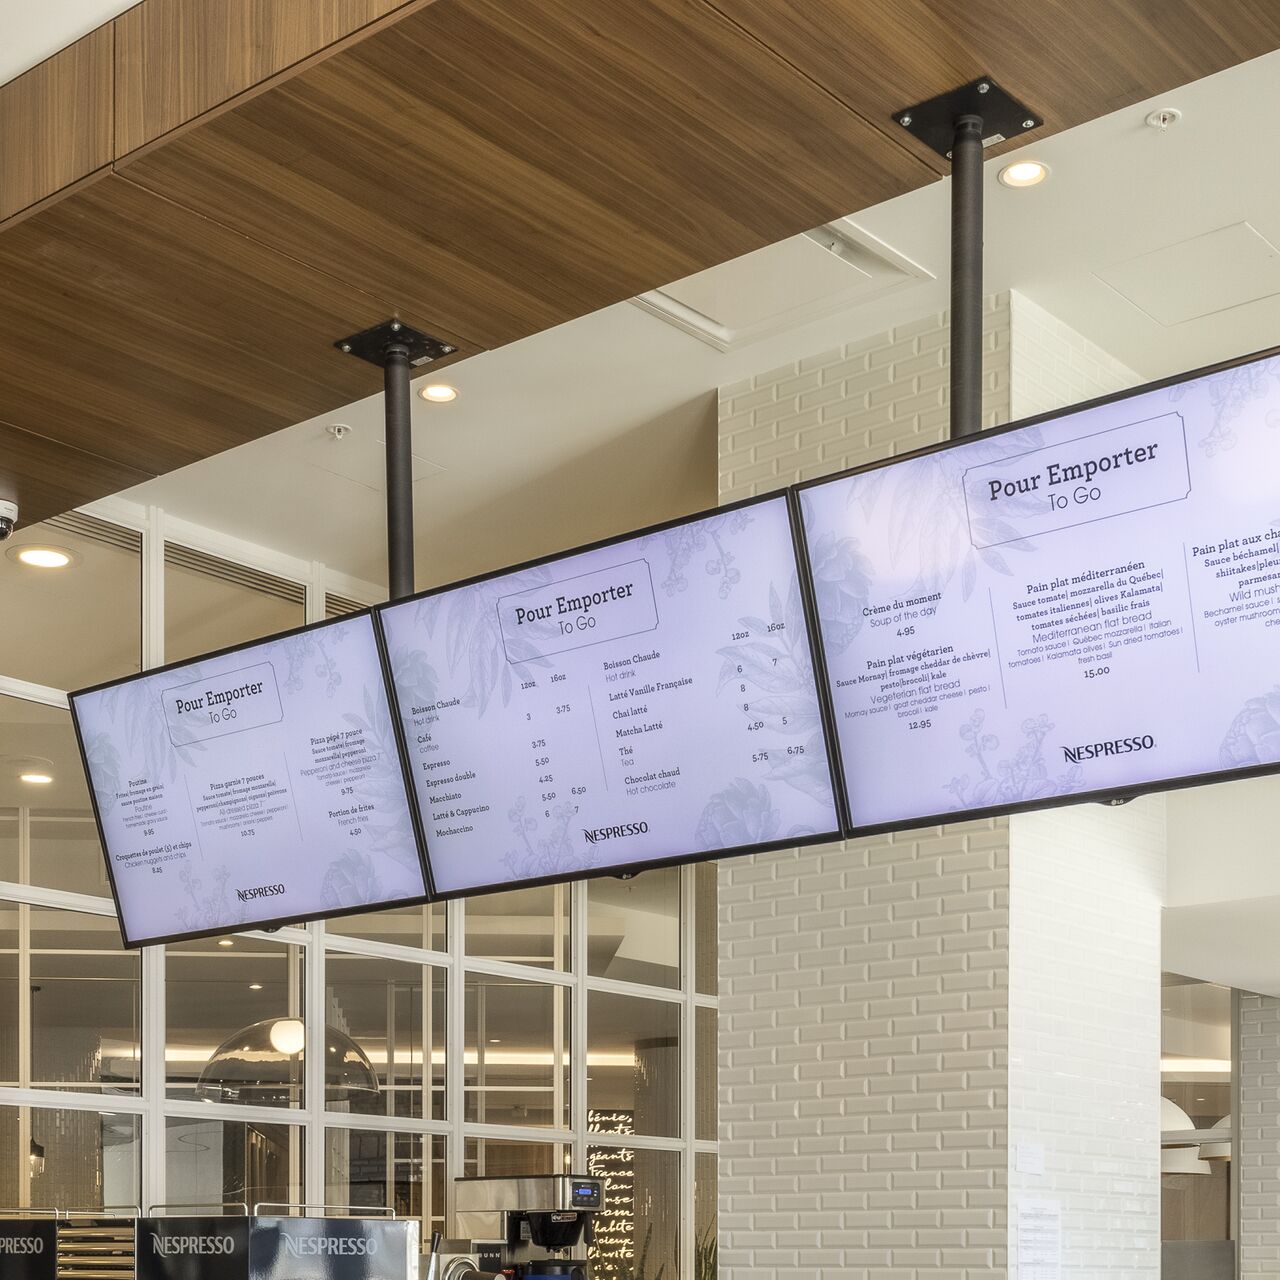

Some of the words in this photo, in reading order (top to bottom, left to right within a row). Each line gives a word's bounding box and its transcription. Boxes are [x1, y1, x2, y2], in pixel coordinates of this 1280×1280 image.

[988, 474, 1041, 502] Pour
[1046, 443, 1158, 486] Emporter
[1047, 493, 1069, 512] To
[1073, 486, 1102, 505] Go
[1192, 544, 1216, 557] Pain
[1218, 539, 1240, 554] plat
[1241, 534, 1262, 546] aux
[1026, 582, 1049, 595] Pain
[1050, 577, 1070, 592] plat
[1071, 561, 1145, 585] méditerranéen
[1228, 588, 1252, 603] Wild
[514, 604, 553, 626] Pour
[555, 583, 634, 615] Emporter
[862, 604, 892, 617] Crème
[892, 599, 904, 610] du
[905, 592, 942, 607] moment
[869, 616, 893, 628] Soup
[893, 612, 902, 623] of
[903, 610, 919, 621] the
[919, 606, 937, 617] day
[557, 620, 574, 636] To
[575, 615, 597, 631] Go
[767, 622, 786, 633] 16oz
[896, 625, 916, 638] 4.95
[1032, 622, 1103, 644] Mediterranean
[1104, 616, 1120, 629] flat
[1121, 609, 1153, 625] bread
[731, 631, 750, 641] 12oz
[602, 658, 632, 671] Boisson
[632, 650, 661, 664] Chaude
[866, 658, 887, 670] Pain
[887, 654, 905, 668] plat
[905, 645, 954, 662] végétarien
[550, 673, 567, 683] 16oz
[1083, 666, 1110, 679] 15.00
[520, 681, 537, 690] 12oz
[608, 689, 629, 702] Latté
[628, 683, 656, 697] Vanille
[655, 677, 693, 692] Française
[917, 684, 932, 695] flat
[933, 679, 961, 692] bread
[175, 697, 204, 715] Pour
[205, 681, 263, 707] Emporter
[411, 704, 437, 716] Boisson
[436, 697, 461, 710] Chaude
[555, 703, 571, 715] 3.75
[612, 708, 631, 720] Chai
[629, 704, 648, 716] latté
[208, 711, 221, 724] To
[221, 707, 237, 721] Go
[615, 725, 643, 738] Matcha
[643, 720, 663, 733] Latté
[908, 719, 932, 730] 12.95
[416, 732, 432, 744] Café
[531, 738, 547, 749] 3.75
[618, 745, 634, 756] Thé
[752, 751, 769, 763] 5.75
[786, 745, 805, 755] 6.75
[1061, 734, 1154, 764] NESPRESSO
[422, 759, 451, 771] Espresso
[535, 756, 550, 767] 5.50
[425, 777, 455, 789] Espresso
[454, 770, 476, 782] double
[538, 774, 554, 784] 4.25
[624, 772, 657, 785] Chocolat
[657, 766, 681, 779] chaud
[571, 786, 587, 795] 6.50
[639, 780, 677, 794] chocolate
[428, 792, 462, 805] Macchiato
[541, 791, 557, 802] 5.50
[432, 810, 450, 821] Latté
[435, 825, 474, 838] Mochaccino
[582, 821, 649, 845] NESPRESSO
[236, 883, 286, 903] NESPRESSO
[149, 1232, 235, 1259] NESPRESSO
[280, 1232, 379, 1259] NESPRESSO
